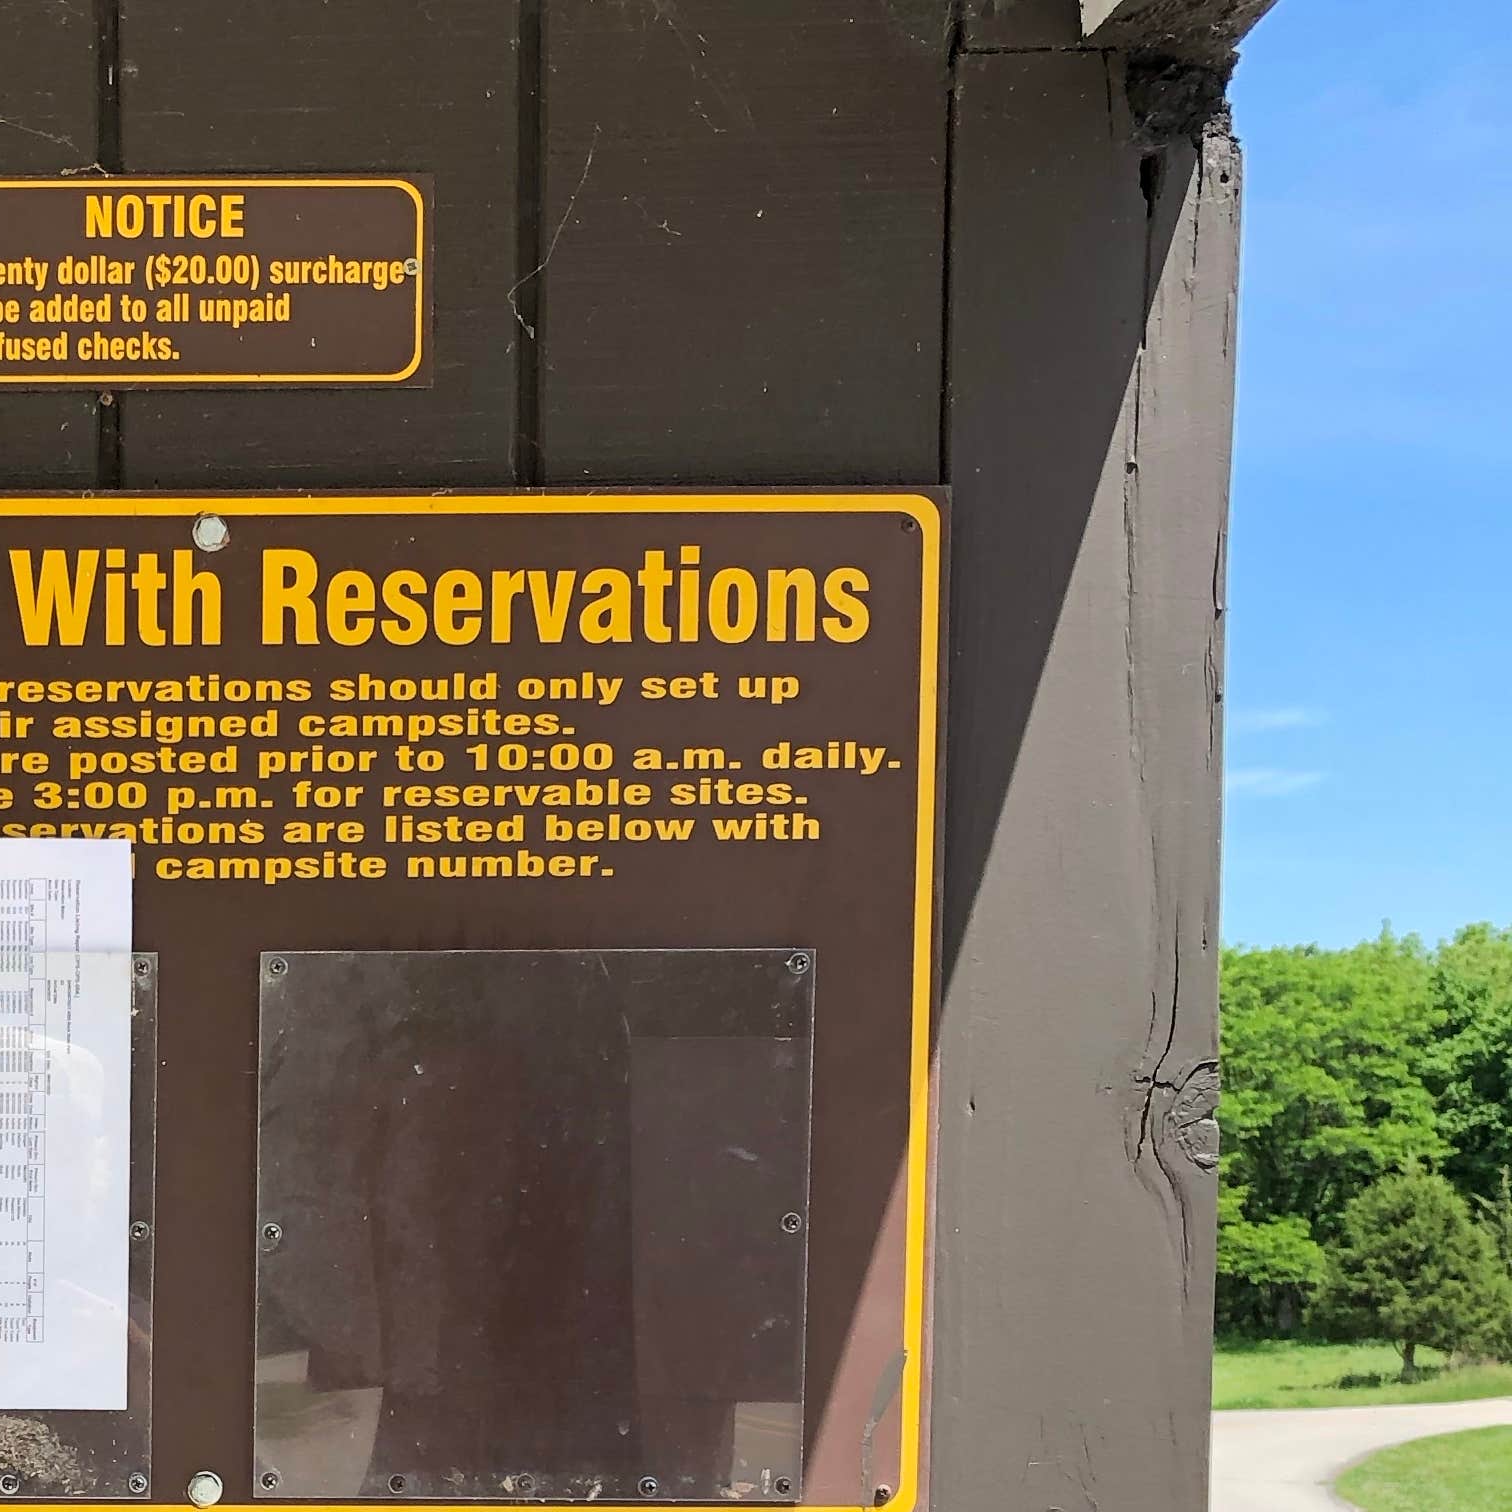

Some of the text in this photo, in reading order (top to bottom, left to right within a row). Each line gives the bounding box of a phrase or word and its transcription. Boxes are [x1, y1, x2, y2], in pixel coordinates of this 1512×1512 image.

[85, 194, 245, 239] NOTICE
[57, 255, 136, 285] dollar
[145, 253, 260, 289] ($20.00)
[269, 254, 407, 290] surcharge
[29, 293, 112, 323] added
[119, 294, 147, 323] to
[155, 292, 190, 323] all
[199, 294, 290, 327] unpaid
[77, 330, 180, 361] checks.
[8, 548, 222, 647] With
[261, 545, 870, 647] Reservations
[329, 672, 498, 701] should
[517, 671, 623, 705] only
[642, 672, 717, 699] set
[738, 676, 800, 705] up
[52, 709, 278, 744] assigned
[298, 707, 574, 743] campsites.
[69, 745, 238, 780] posted
[258, 744, 378, 779] prior
[395, 745, 445, 772] to
[466, 742, 613, 771] 10:00
[633, 748, 740, 770] a.m.
[762, 741, 899, 775] daily.
[34, 781, 147, 810] 3:00
[167, 786, 274, 815] p.m.
[292, 780, 364, 808] for
[383, 778, 652, 807] reservable
[672, 777, 805, 805] sites.
[283, 821, 365, 843] are
[385, 814, 524, 843] listed
[545, 813, 695, 842] below
[713, 812, 820, 841] with
[155, 850, 387, 885] campsite
[407, 849, 612, 878] number.
